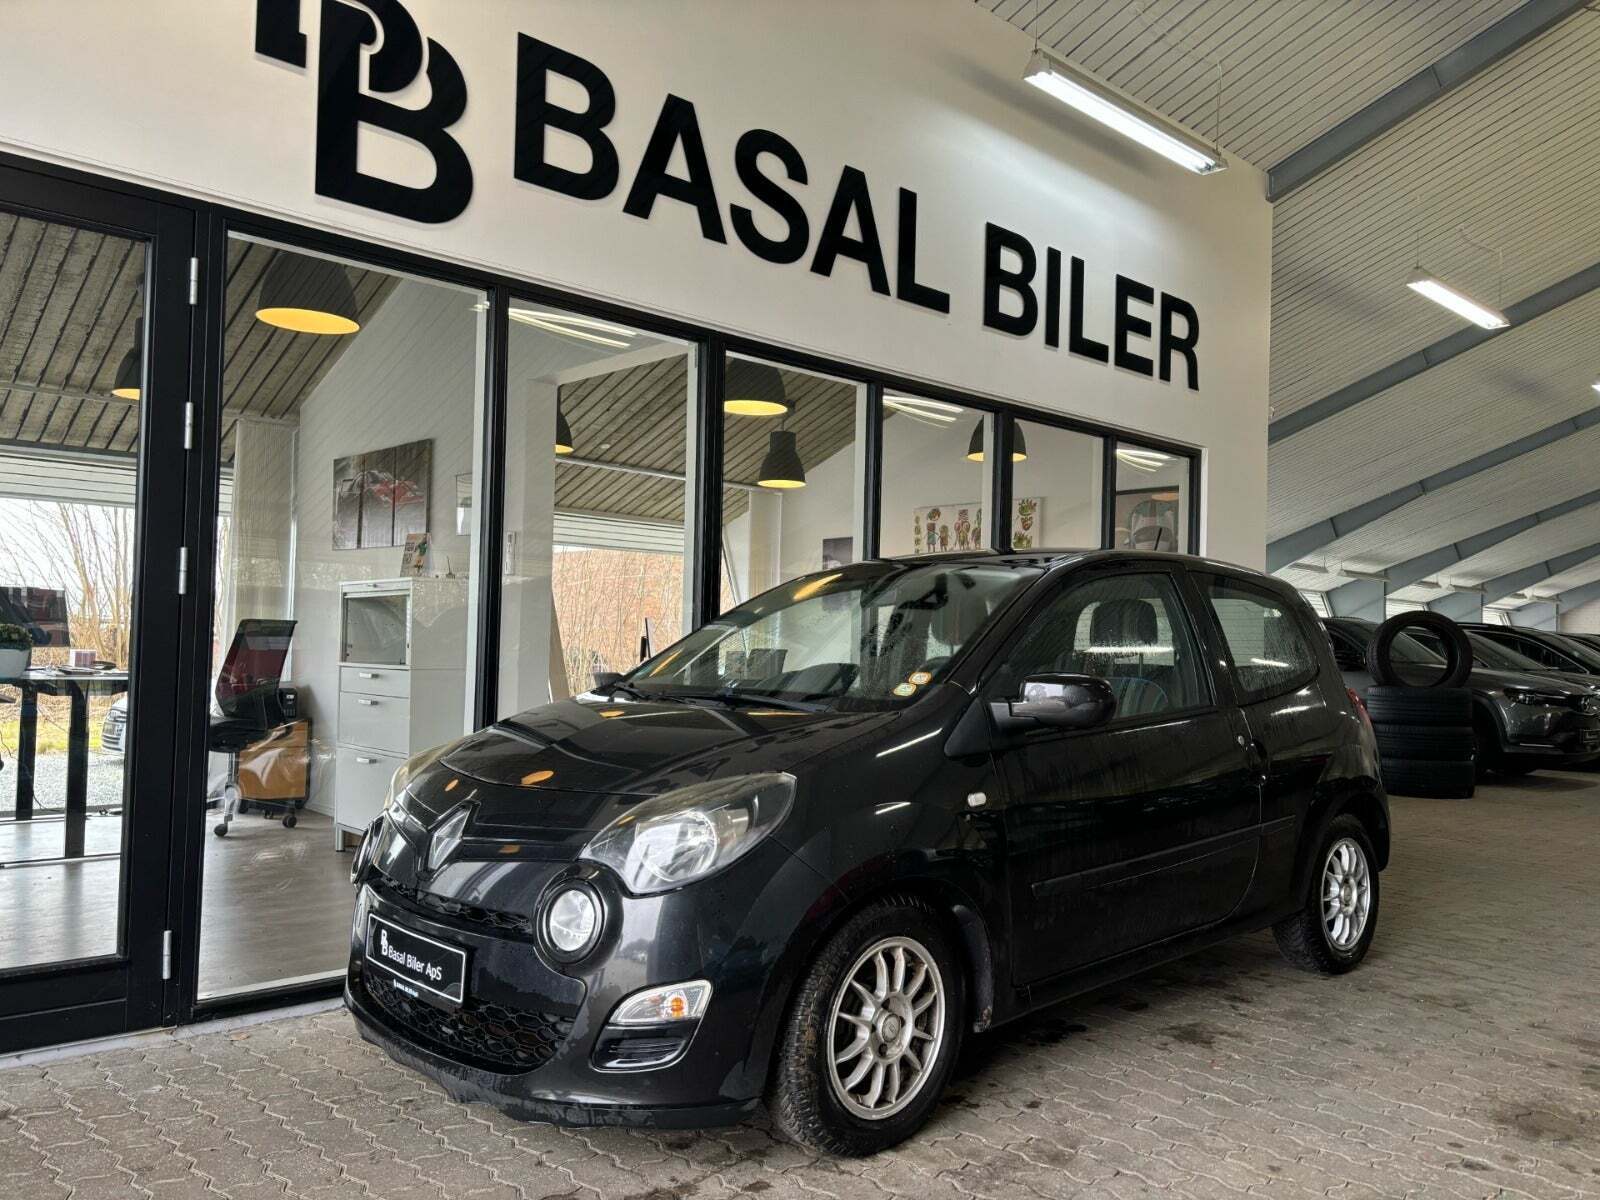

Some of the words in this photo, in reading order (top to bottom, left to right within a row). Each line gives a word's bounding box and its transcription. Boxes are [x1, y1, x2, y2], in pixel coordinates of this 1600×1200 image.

[513, 31, 950, 315] BASAL
[983, 221, 1200, 391] BILER
[388, 945, 406, 965] Basal
[406, 954, 425, 973] Biler
[425, 962, 442, 981] ApS
